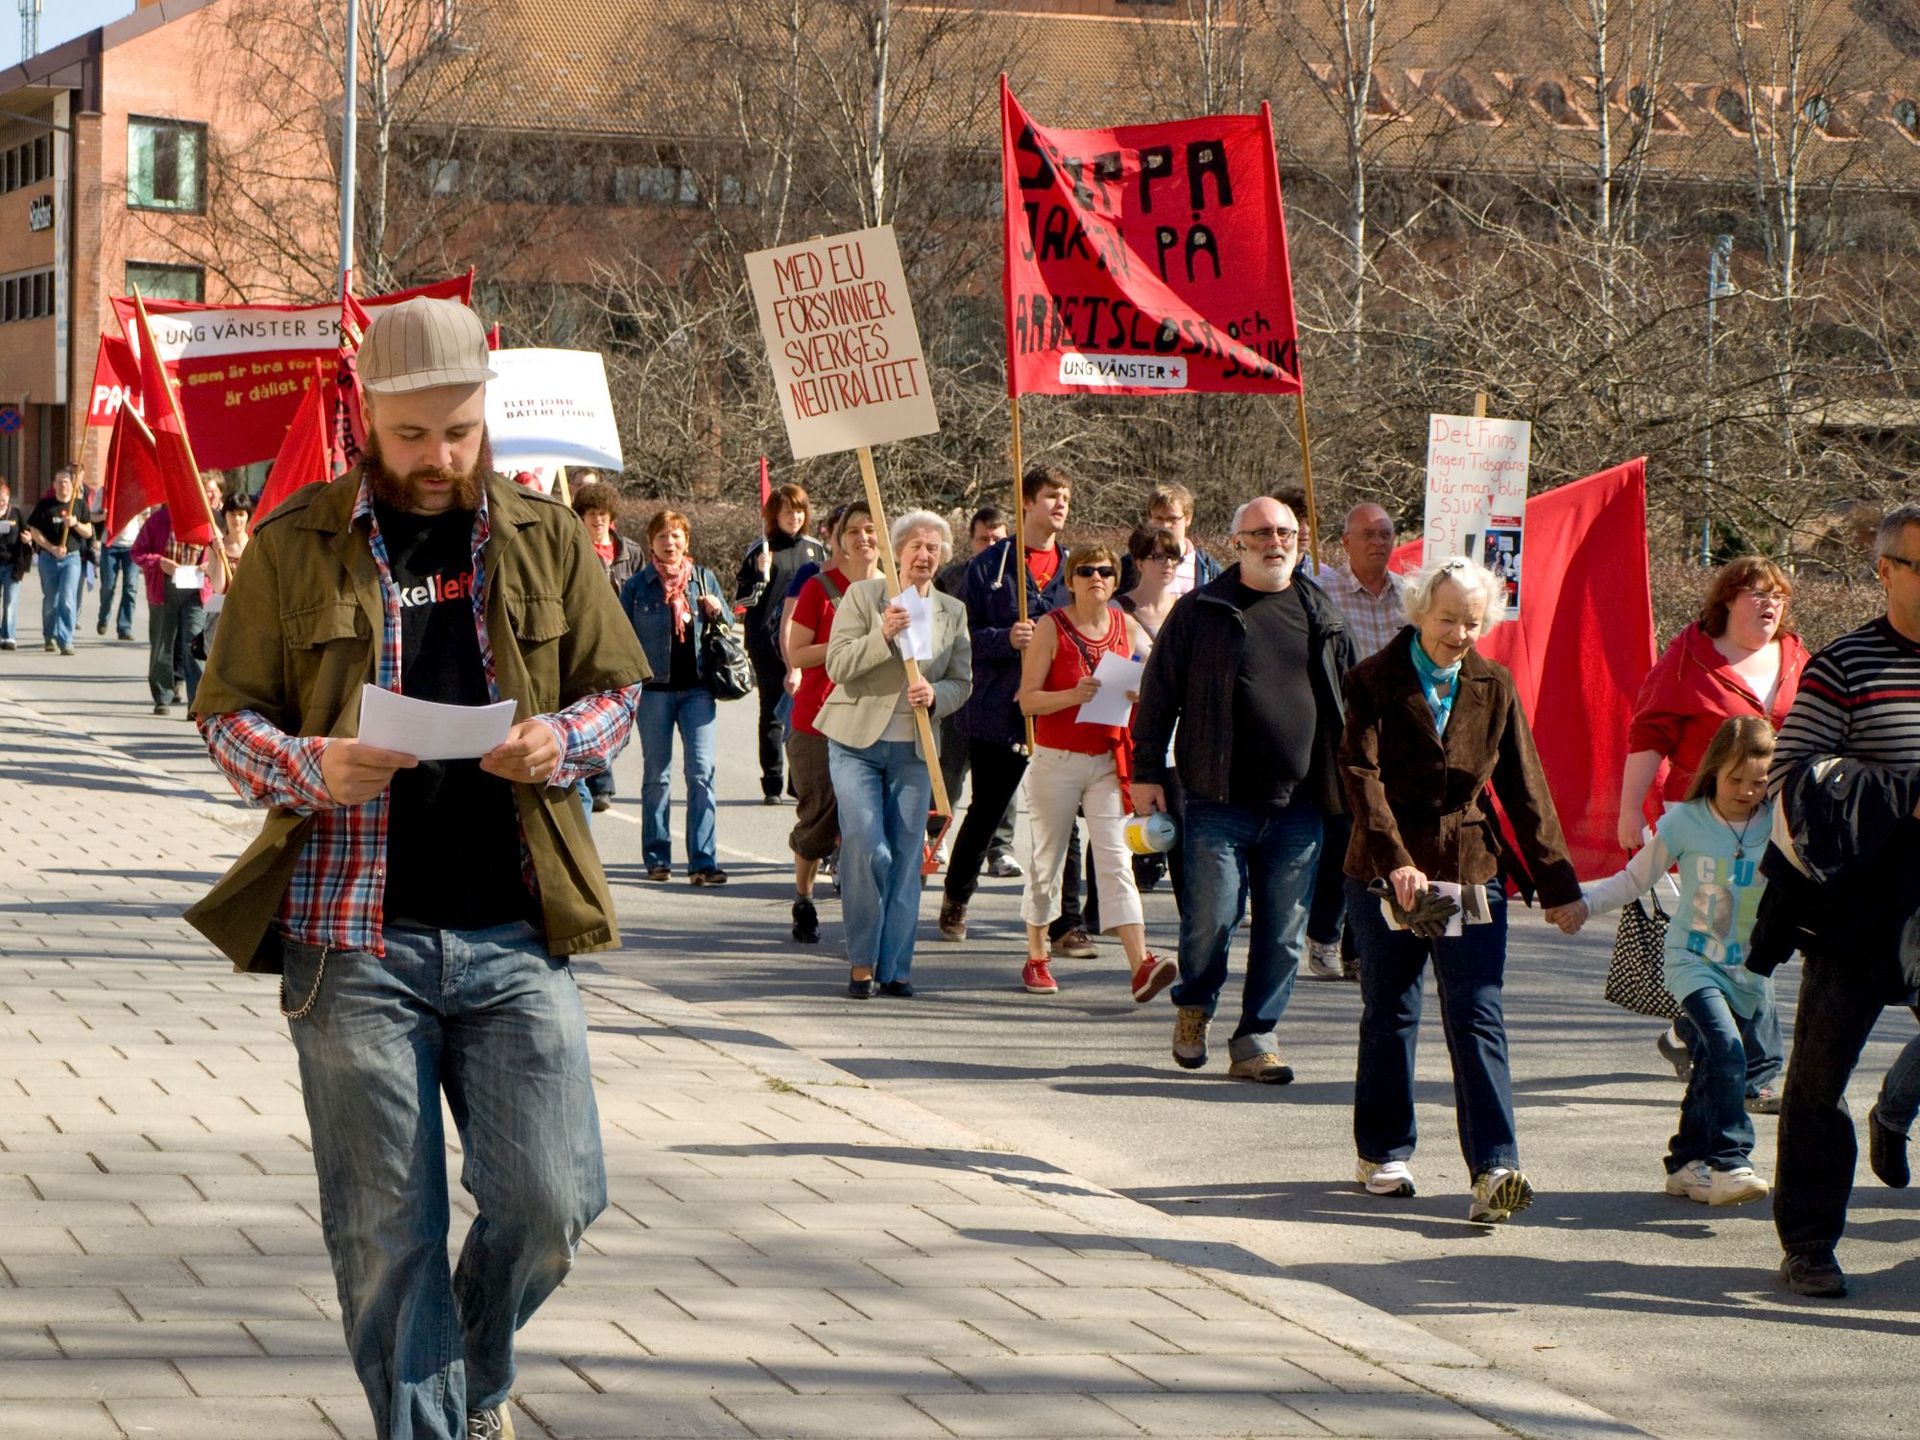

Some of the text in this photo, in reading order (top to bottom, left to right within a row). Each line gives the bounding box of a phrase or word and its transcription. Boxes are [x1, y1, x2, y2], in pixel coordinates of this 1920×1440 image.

[1156, 212, 1220, 283] PÅ
[773, 242, 865, 295] MED EU
[773, 280, 895, 338] FÖRSVINNER
[166, 318, 342, 344] UNG VÄNSTER SK
[1228, 311, 1271, 340] och
[785, 323, 888, 377] SVERIGES
[303, 376, 330, 390] fr
[1064, 359, 1166, 379] UNG VÄNSTER
[789, 358, 920, 419] NEUTRALITET
[1432, 419, 1517, 450] Det Finns
[1432, 448, 1465, 476] Ingen
[1461, 483, 1490, 494] man
[1498, 481, 1524, 496] blir
[1697, 856, 1765, 888] CLU
